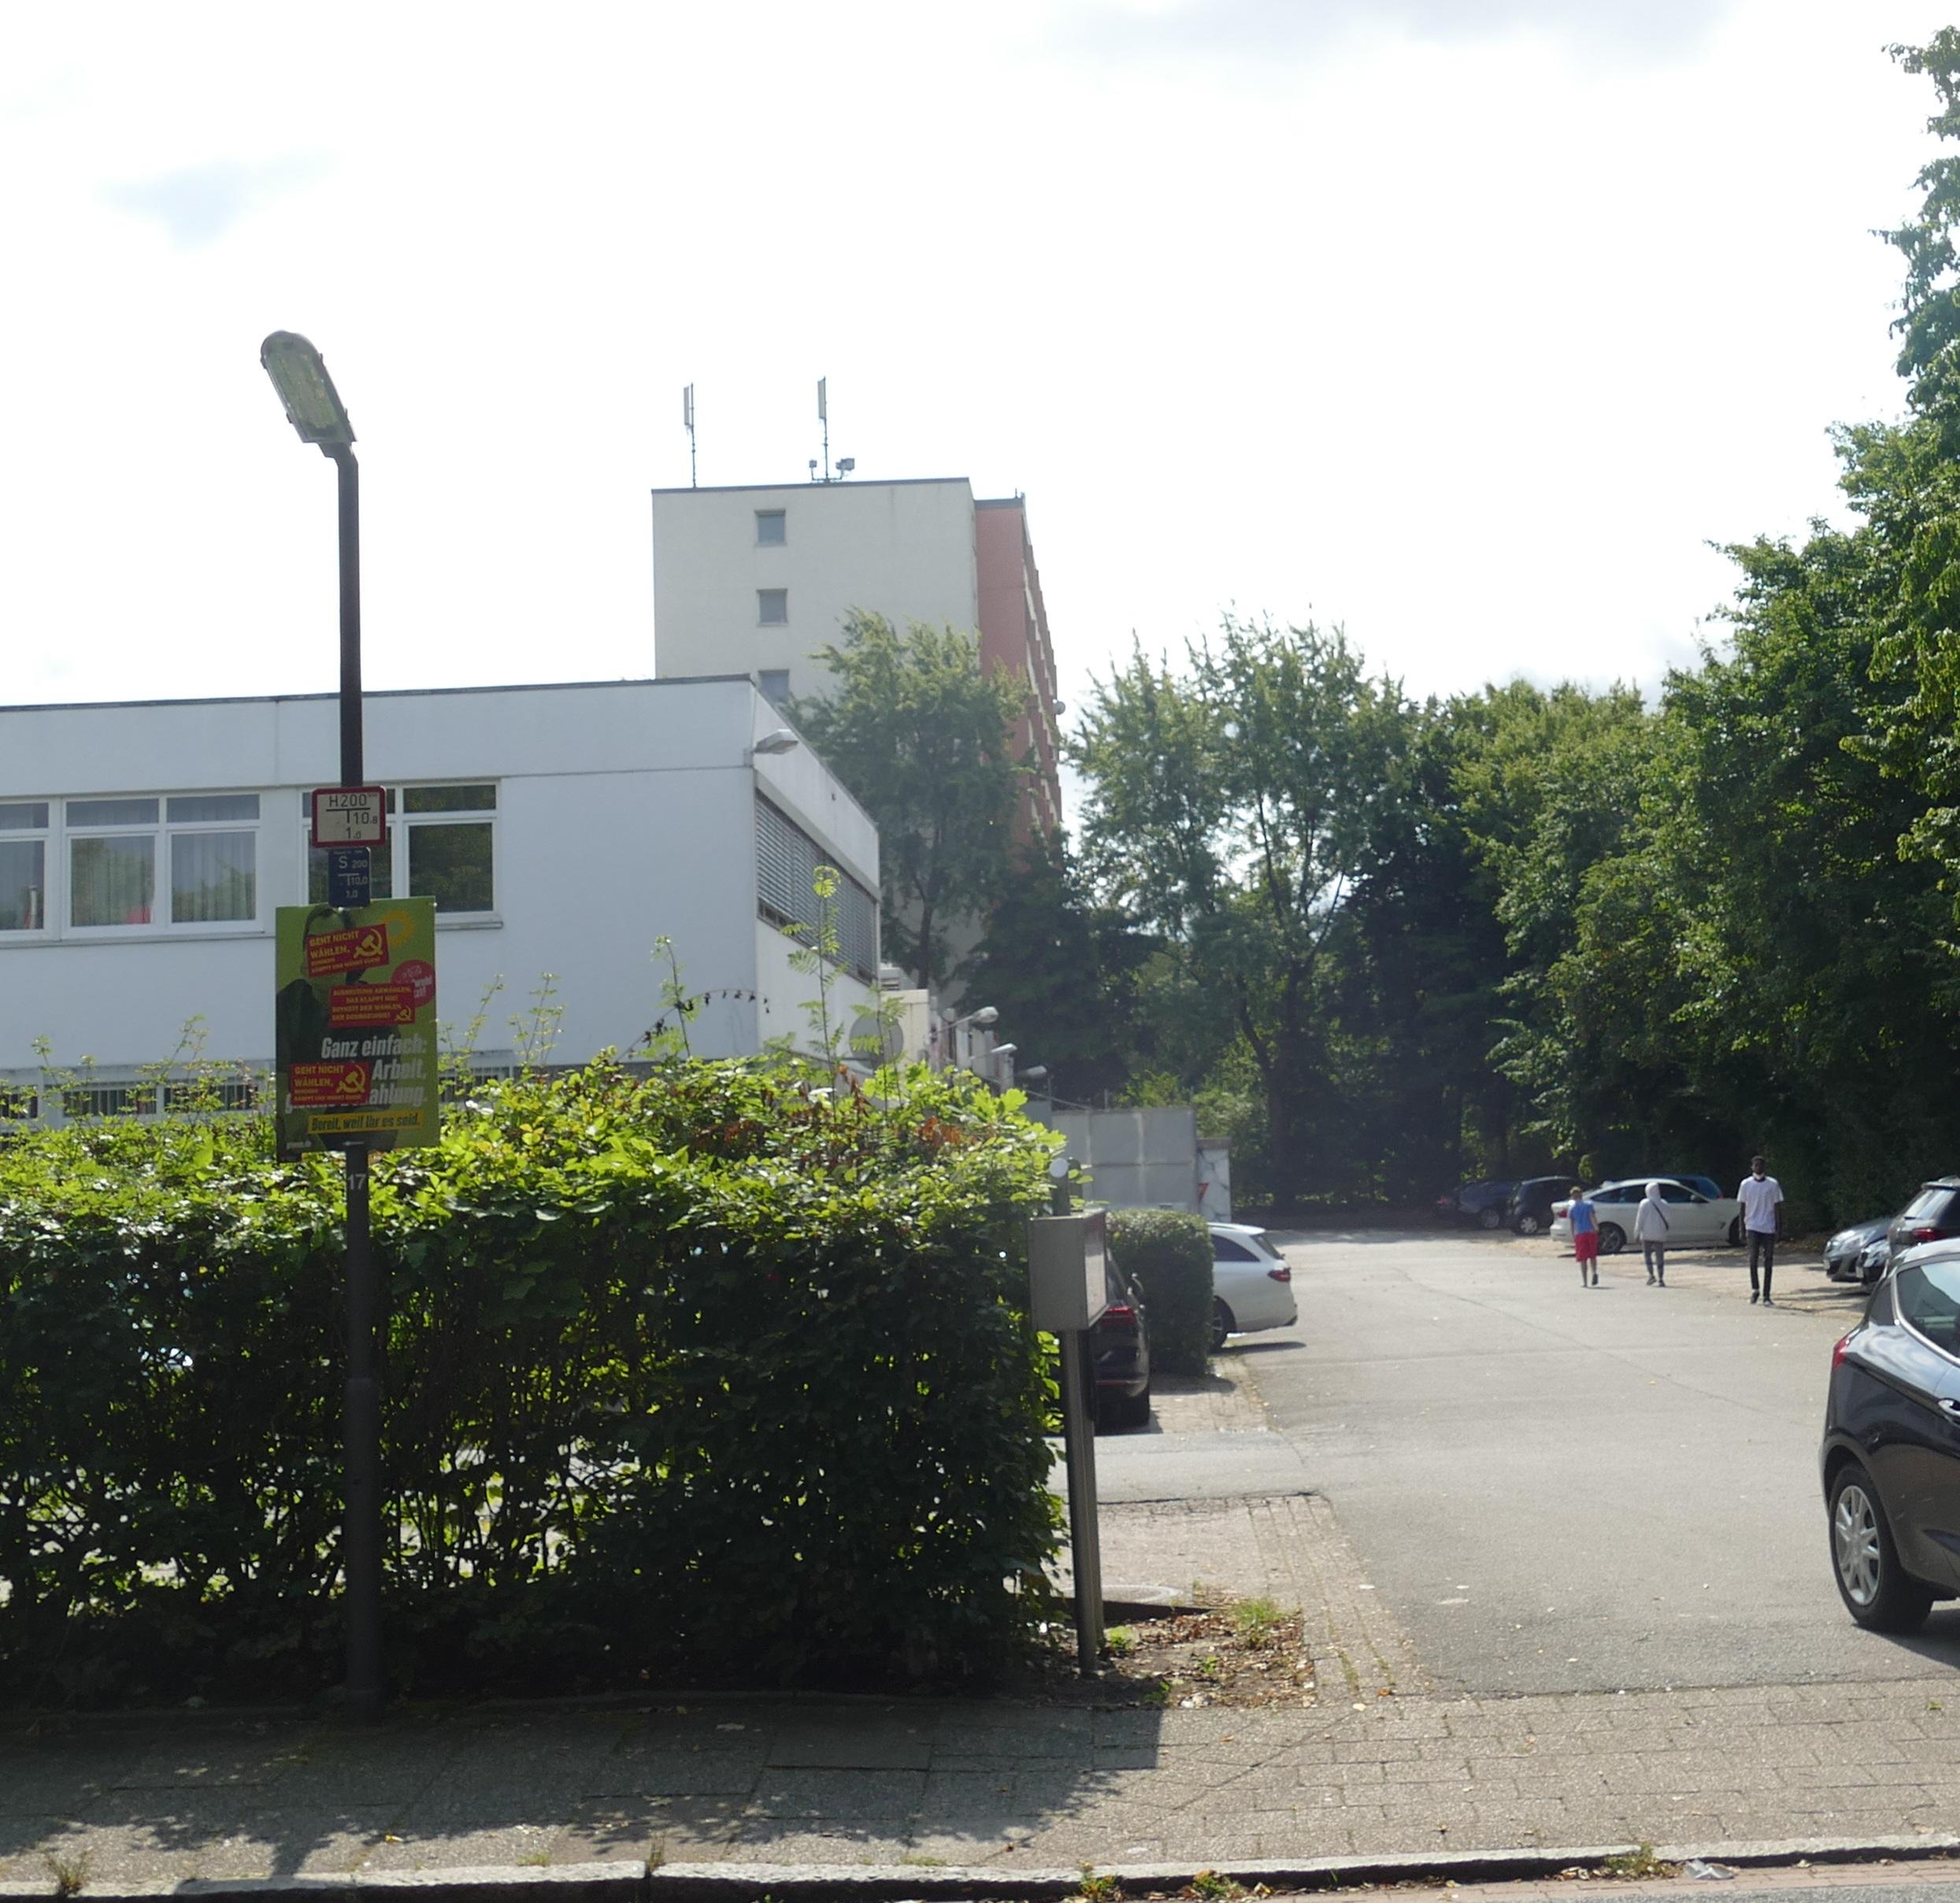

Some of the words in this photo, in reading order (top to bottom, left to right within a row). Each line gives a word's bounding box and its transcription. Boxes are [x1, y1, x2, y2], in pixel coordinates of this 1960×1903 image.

[329, 794, 367, 807] H200
[339, 856, 347, 868] S
[309, 935, 332, 946] GEHT
[332, 931, 359, 942] NICHT
[321, 1037, 359, 1059] Ganz
[295, 1065, 317, 1075] GEHT
[318, 1064, 345, 1074] NICHT
[368, 1082, 428, 1107] ahlung.
[343, 1116, 363, 1129] weil
[350, 1174, 366, 1190] 17
